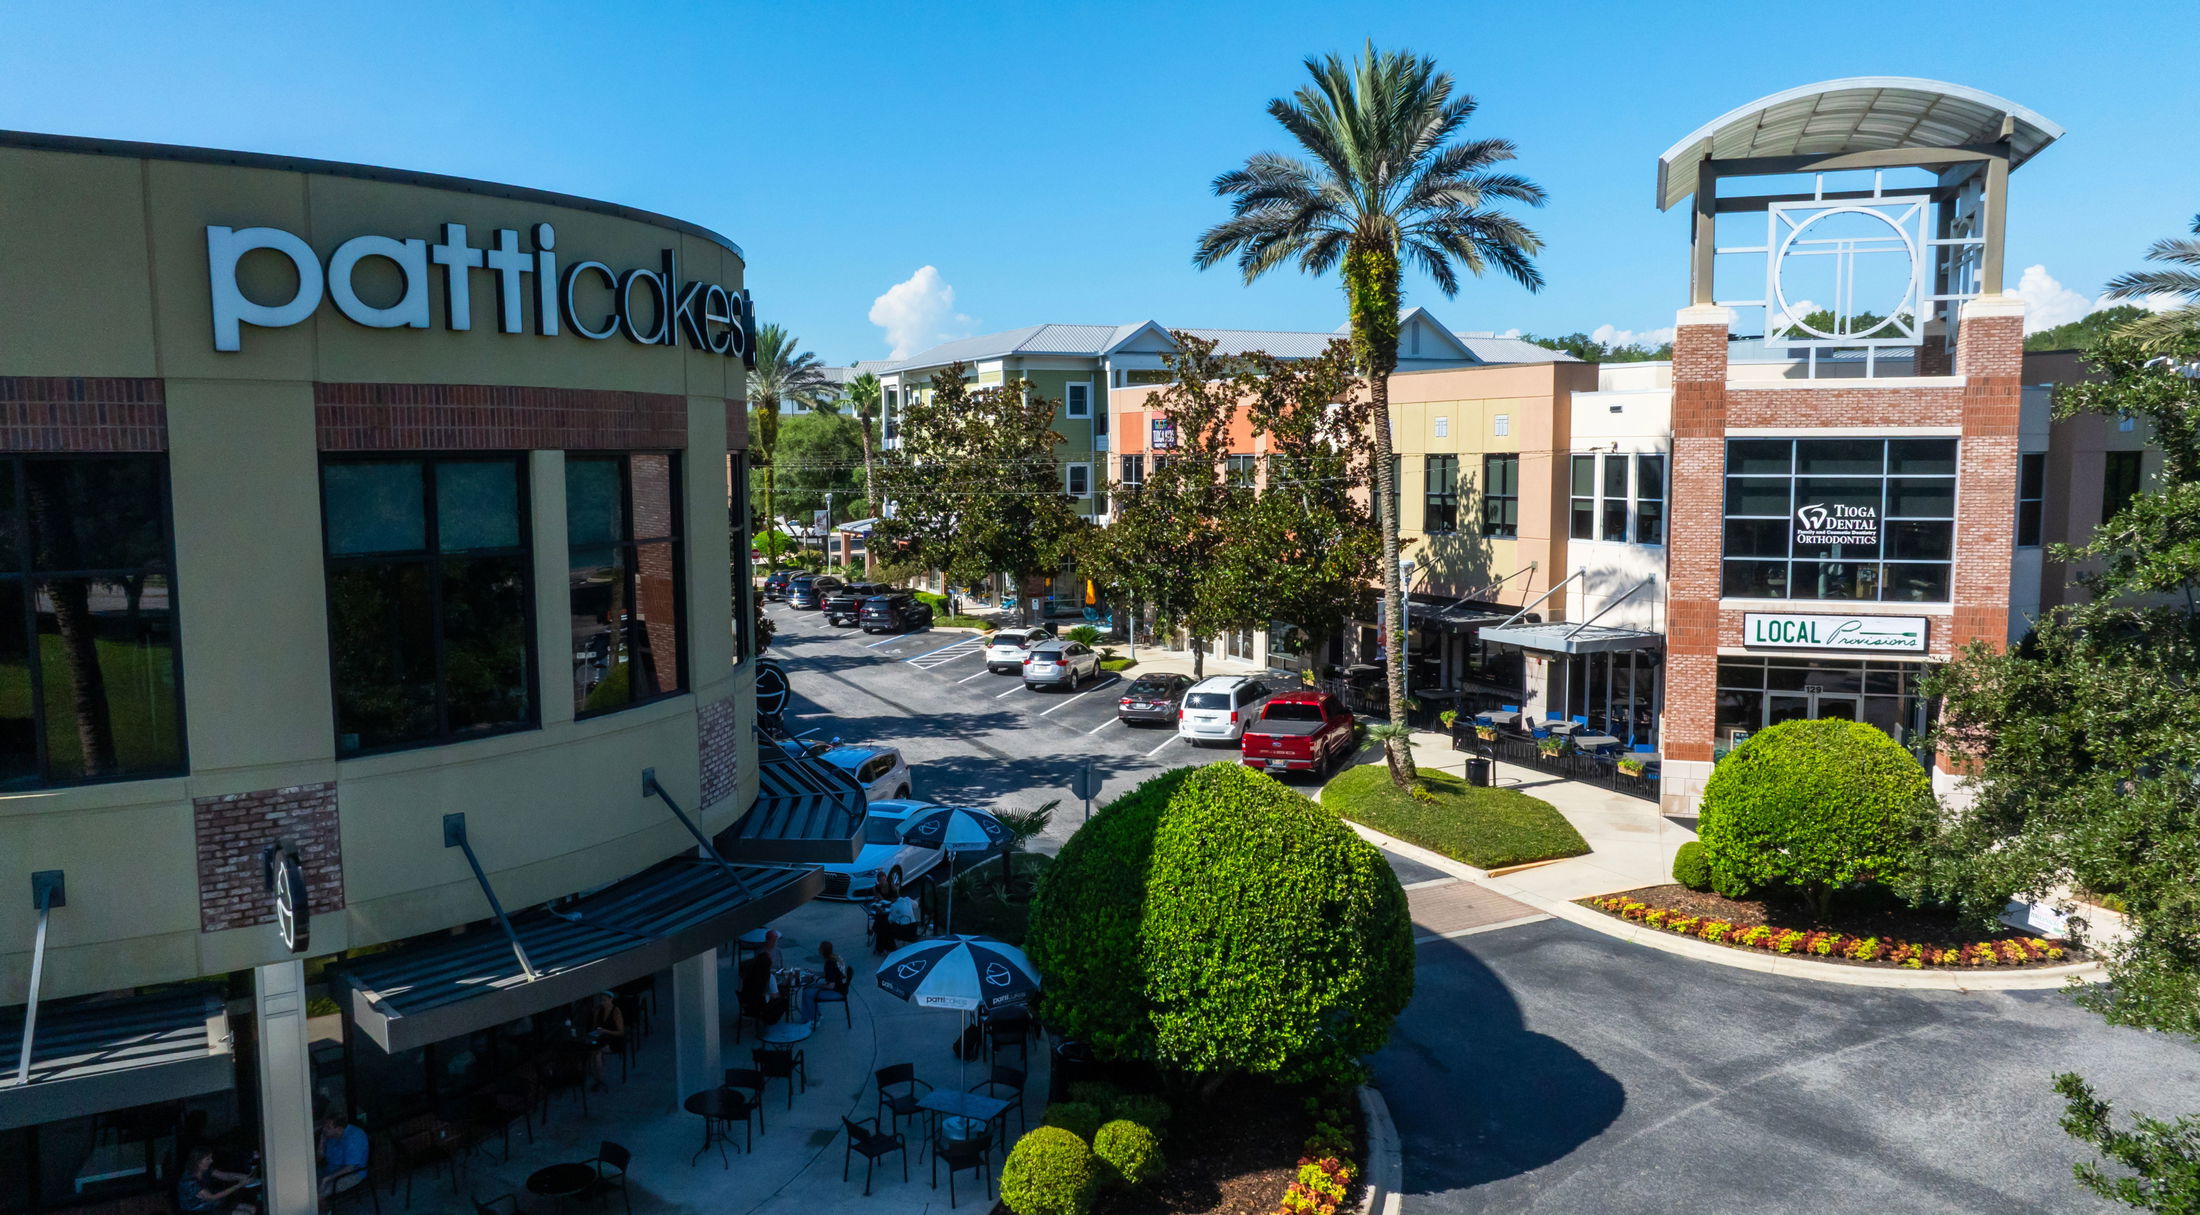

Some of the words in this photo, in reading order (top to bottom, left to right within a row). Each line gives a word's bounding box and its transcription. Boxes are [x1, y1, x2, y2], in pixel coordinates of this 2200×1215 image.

[206, 222, 744, 358] patticakes
[1834, 504, 1876, 517] TIOGA
[1826, 517, 1876, 530] DENTAL
[1797, 534, 1877, 545] ORTHODONTICS
[1756, 619, 1821, 644] LOCAL
[1826, 619, 1918, 646] Provisions
[1806, 686, 1822, 694] 129
